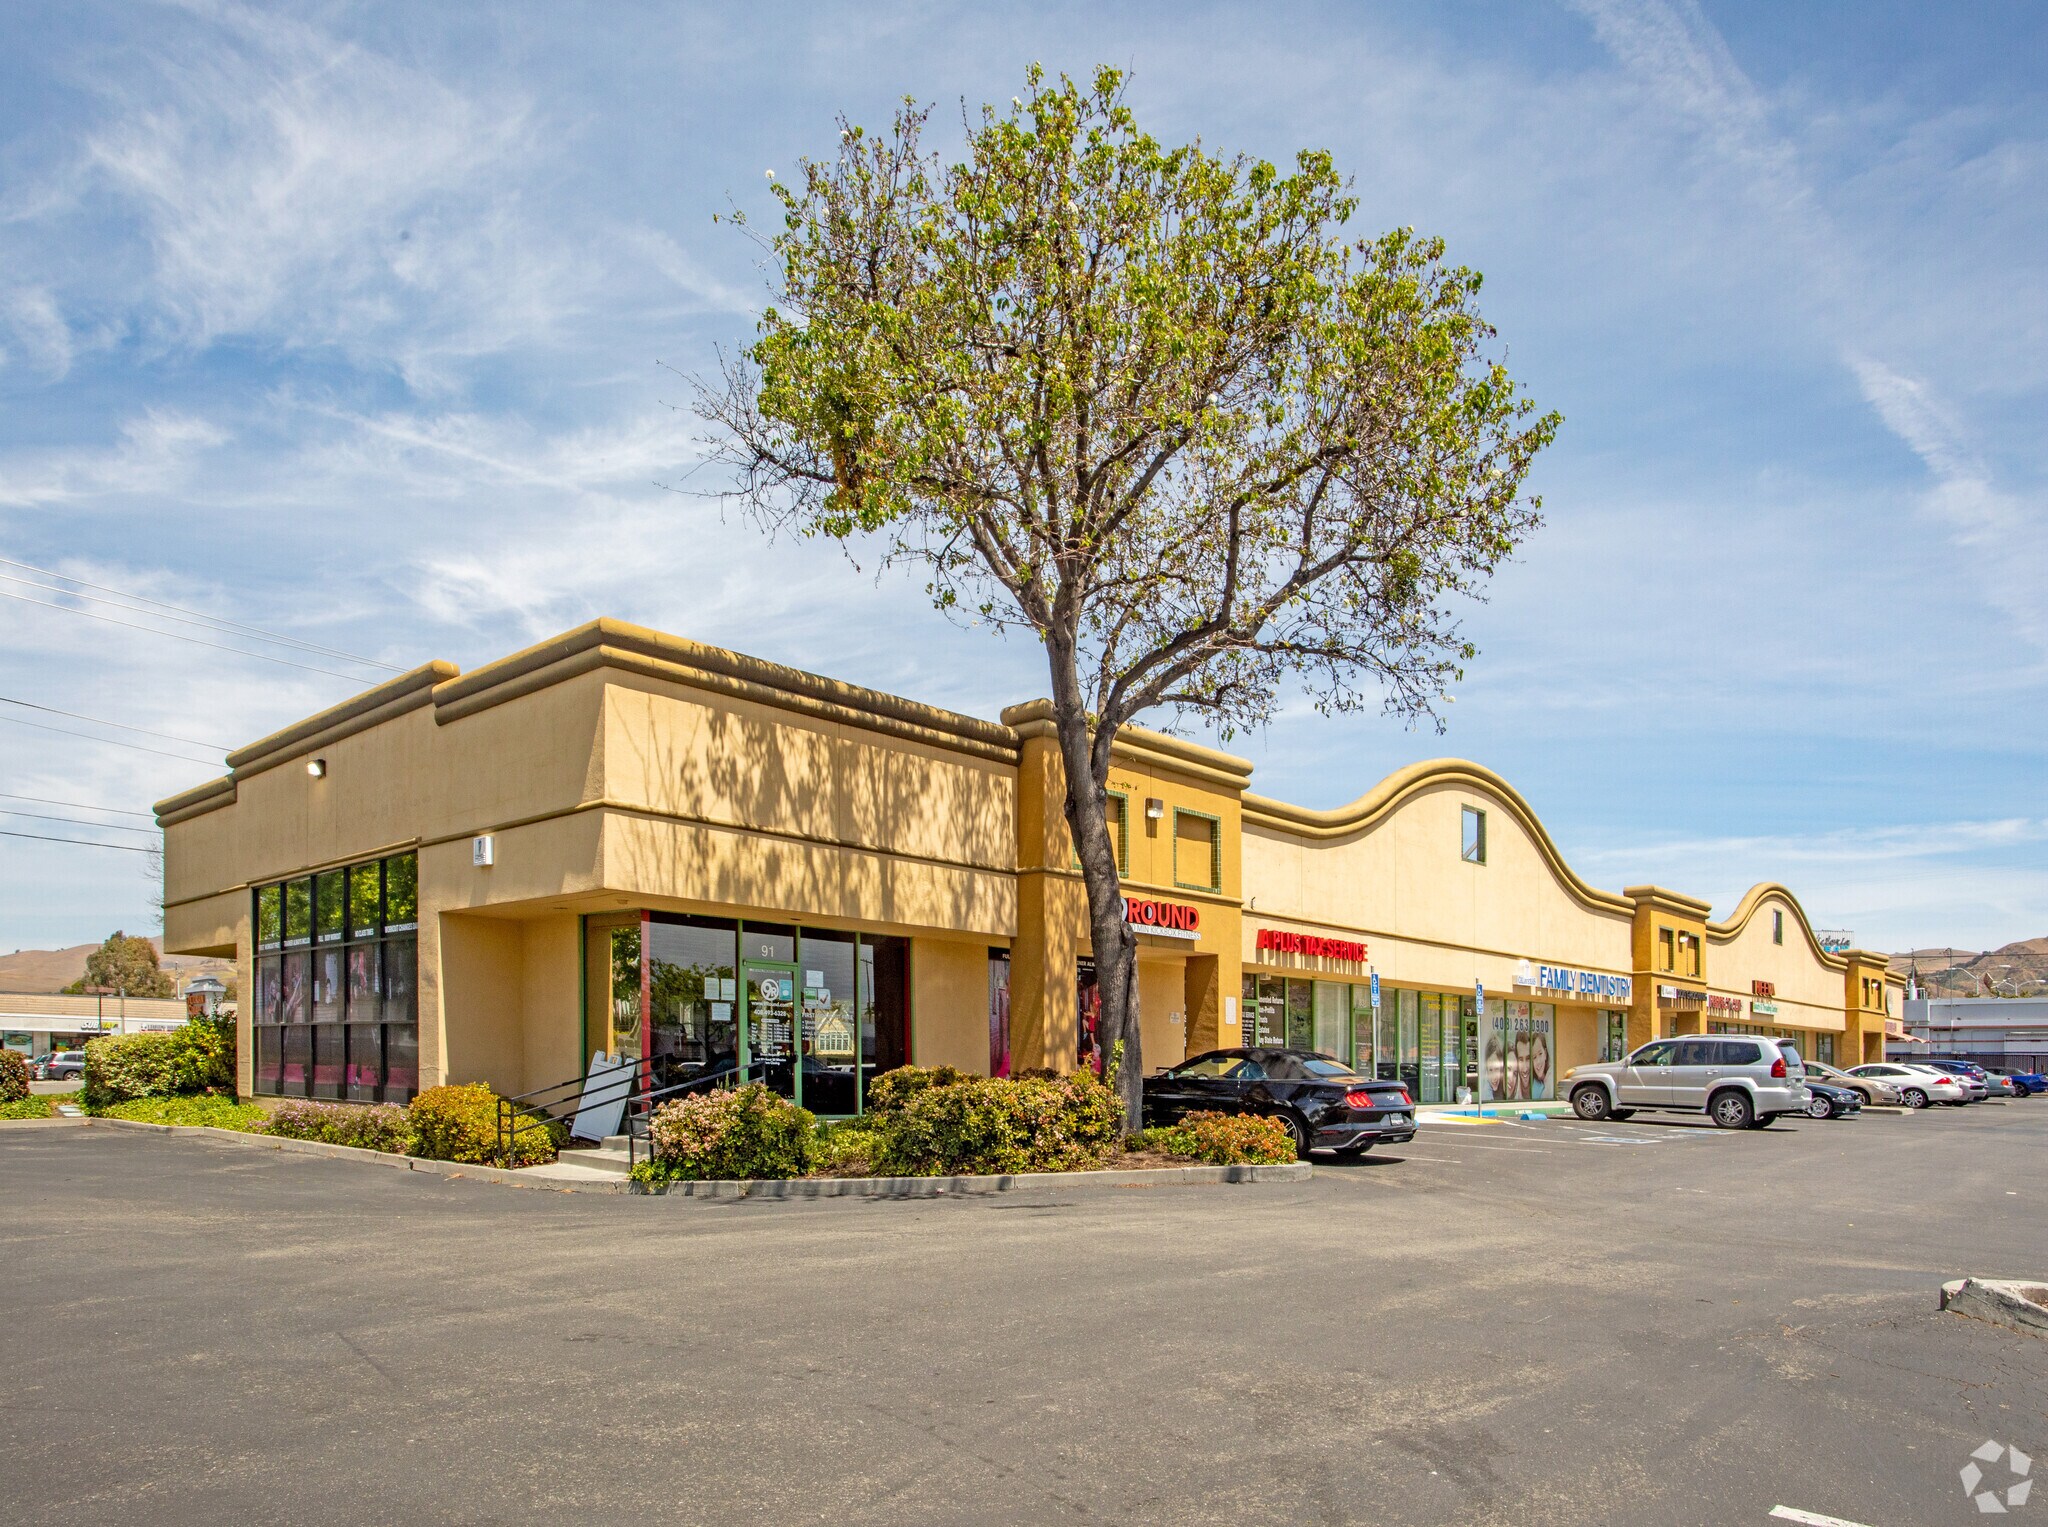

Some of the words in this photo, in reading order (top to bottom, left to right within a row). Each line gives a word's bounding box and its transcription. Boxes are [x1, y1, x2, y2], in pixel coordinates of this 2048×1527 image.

[1150, 927, 1176, 937] KICKBOX
[1177, 931, 1200, 939] FITNESS
[761, 944, 774, 957] 91
[1271, 930, 1300, 953] PLUS
[1301, 935, 1325, 956] TAX
[1324, 939, 1368, 962] SERVICE
[1540, 966, 1576, 991] FAMILY
[1580, 972, 1632, 998] DENTISTRY
[1514, 1018, 1529, 1031] 263
[1530, 1019, 1549, 1032] 0900
